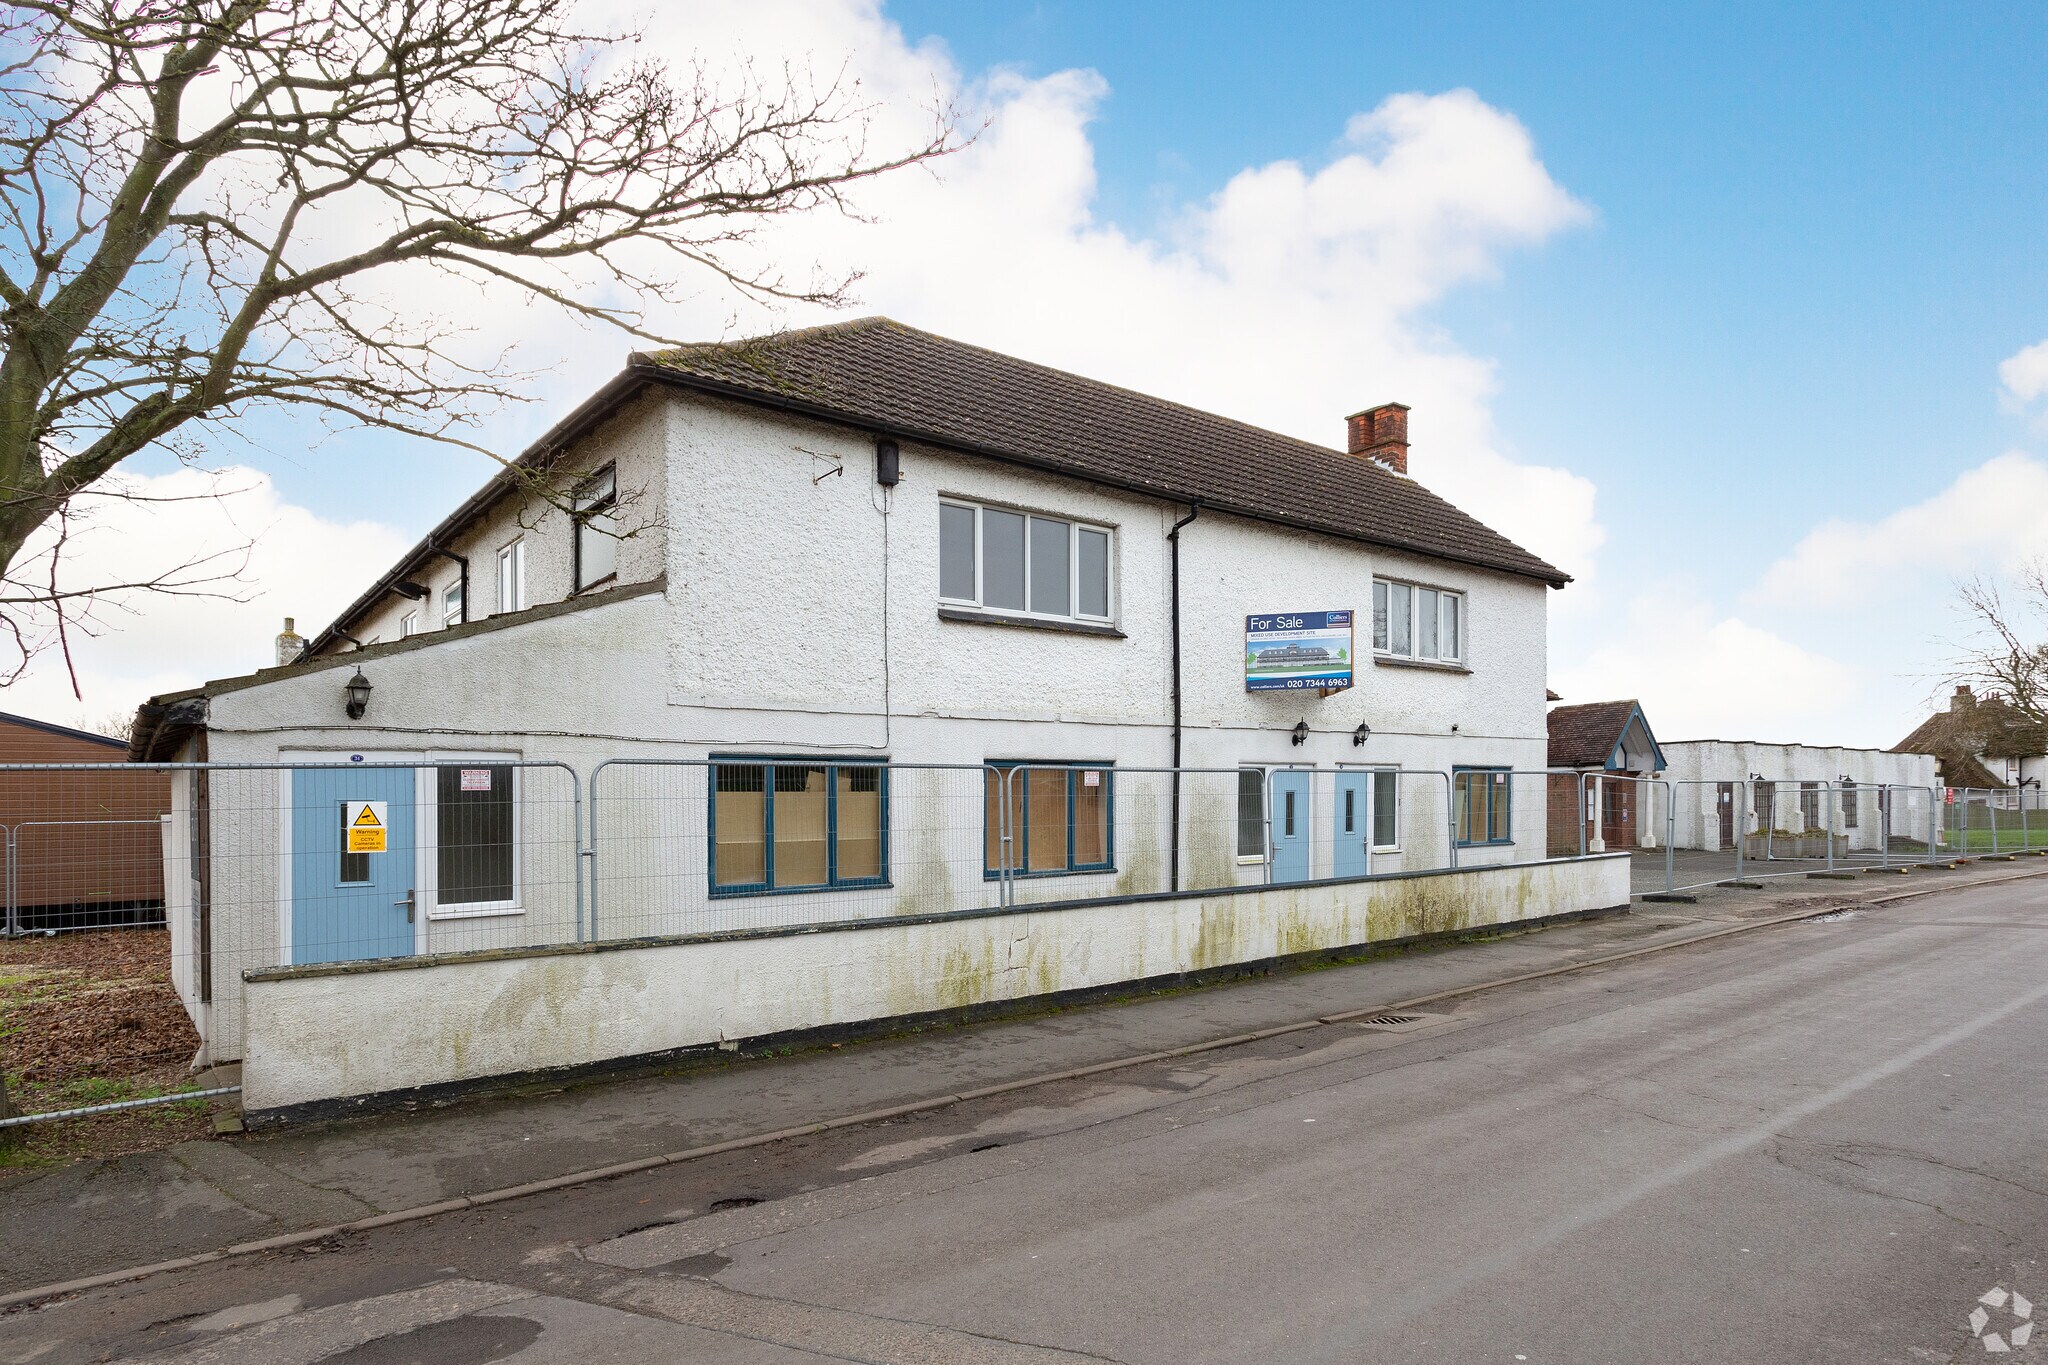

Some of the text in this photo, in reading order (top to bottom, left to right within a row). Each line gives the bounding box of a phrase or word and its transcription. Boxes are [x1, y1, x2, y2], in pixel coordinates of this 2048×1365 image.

[1250, 615, 1303, 630] For Sale
[1287, 678, 1348, 688] 020 7344 6963
